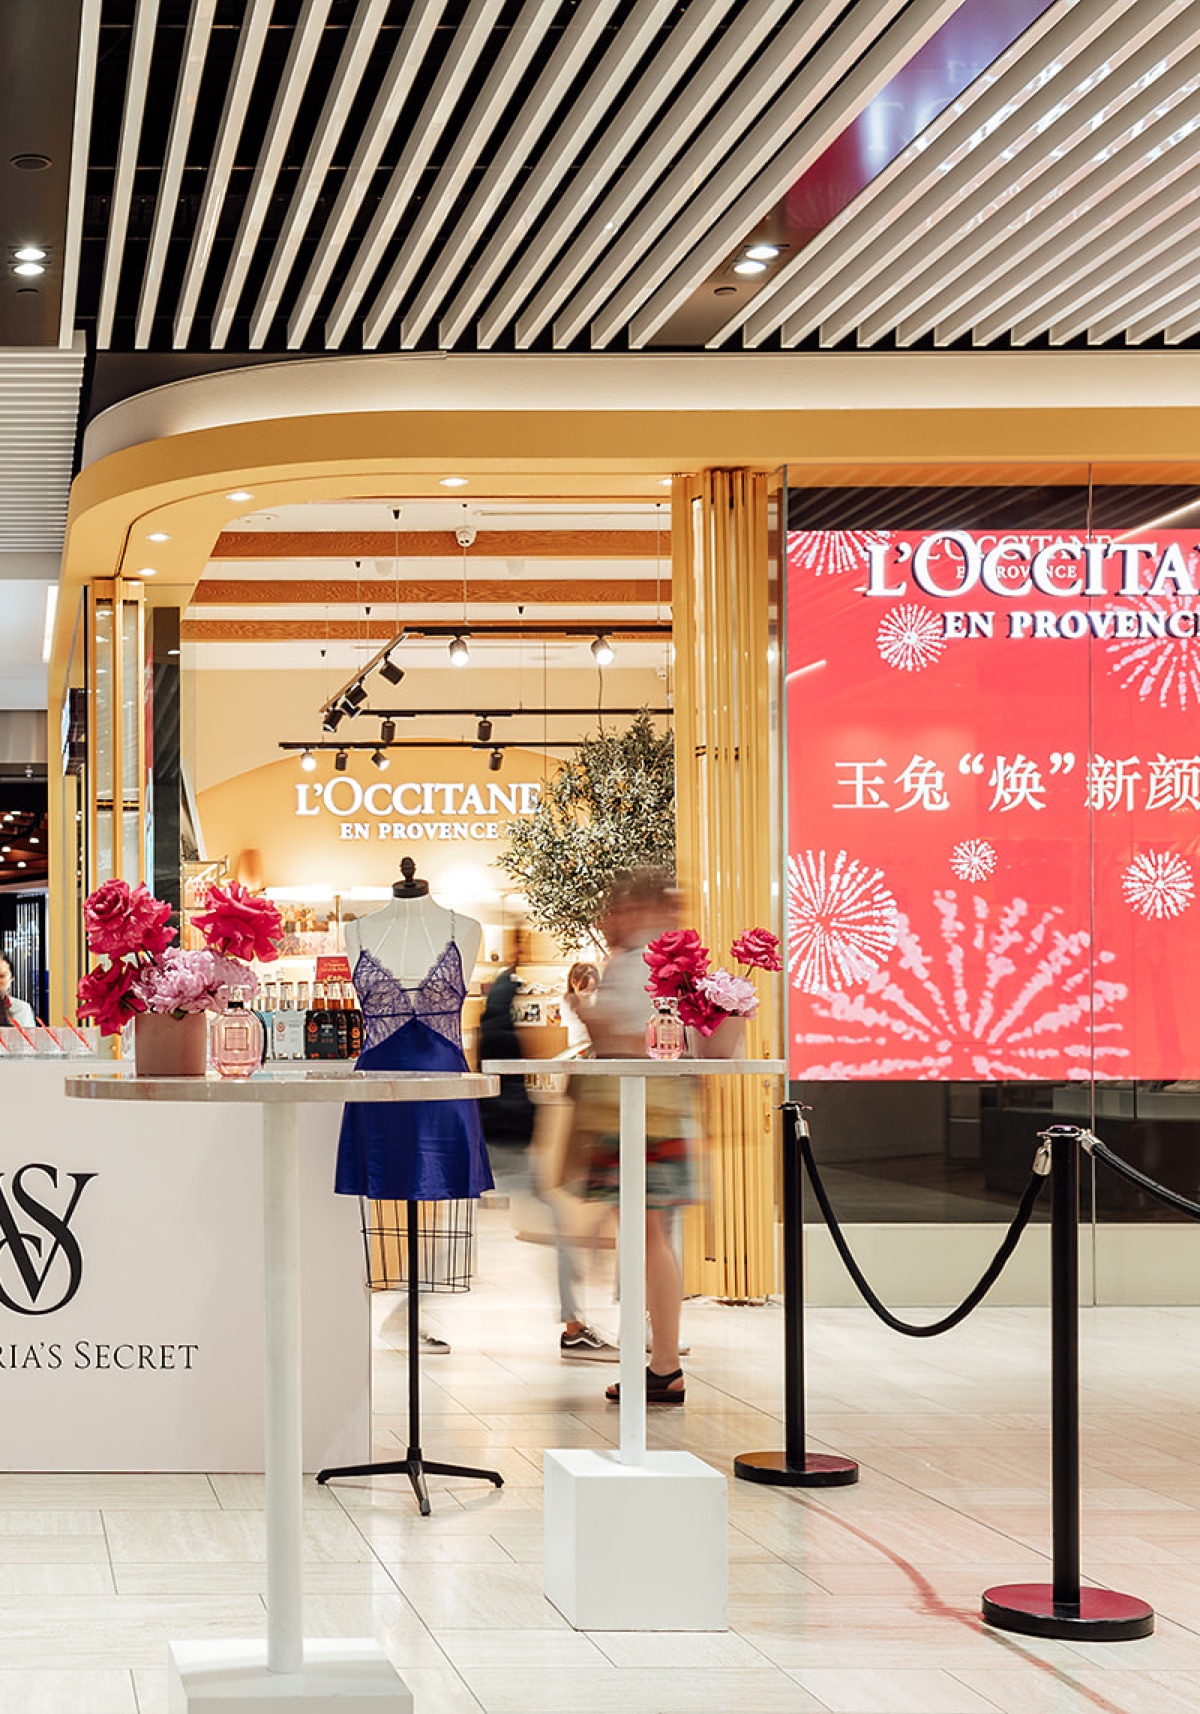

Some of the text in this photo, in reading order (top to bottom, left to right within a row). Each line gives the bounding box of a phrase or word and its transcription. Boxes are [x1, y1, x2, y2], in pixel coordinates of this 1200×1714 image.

[863, 530, 1200, 596] L'OCCITA
[996, 565, 1077, 578] ROVNCE
[942, 611, 1200, 638] EN PROVENC
[294, 776, 542, 816] L'OCCITANE
[340, 822, 499, 840] EN PROVENCE
[74, 1340, 199, 1370] SECRET
